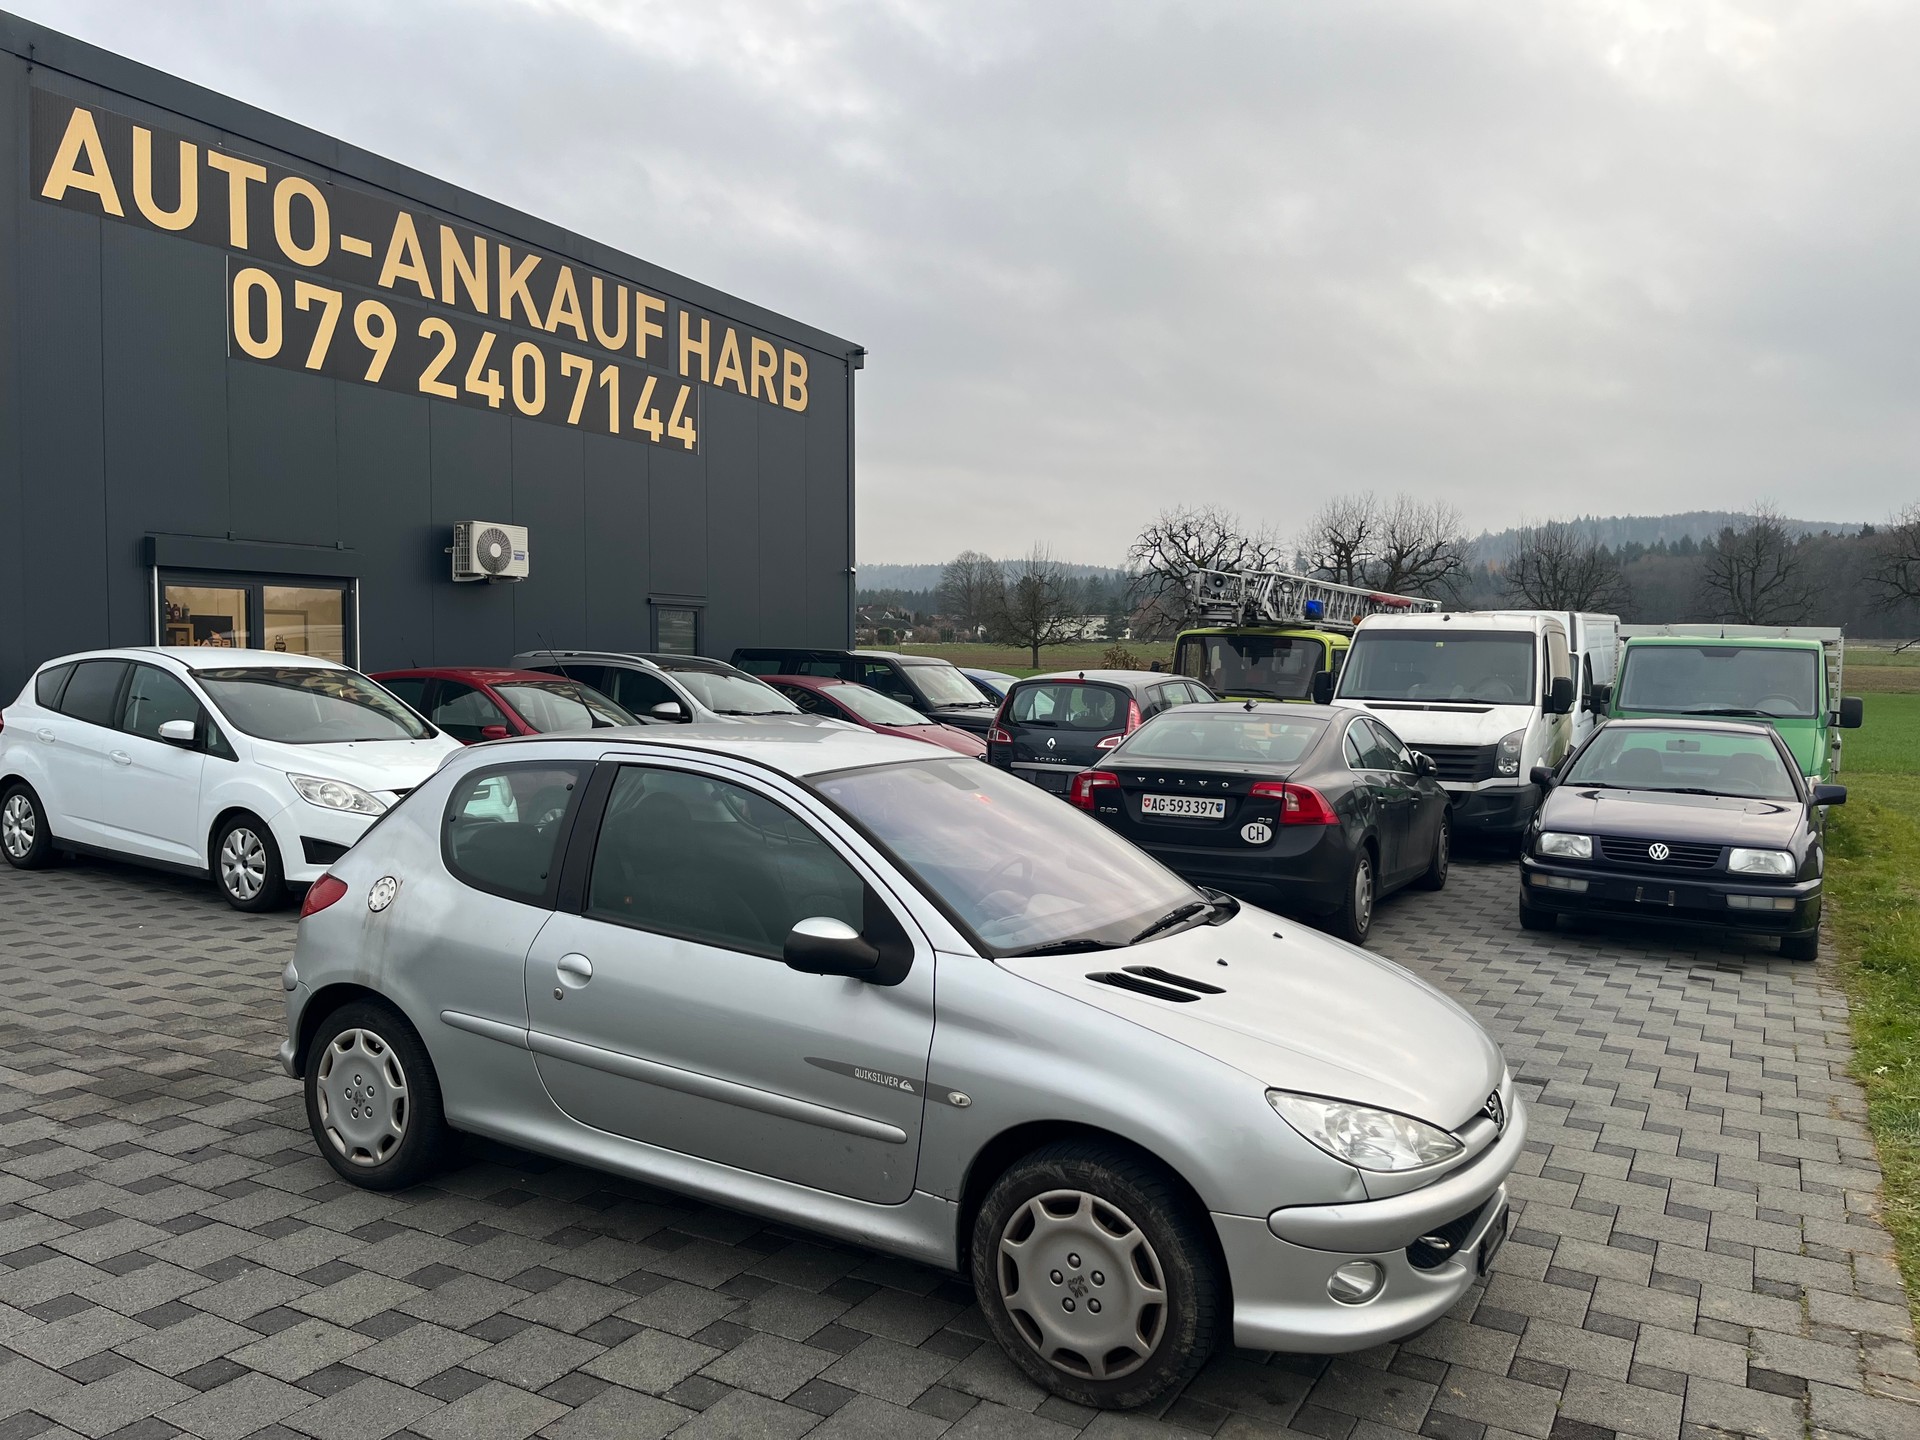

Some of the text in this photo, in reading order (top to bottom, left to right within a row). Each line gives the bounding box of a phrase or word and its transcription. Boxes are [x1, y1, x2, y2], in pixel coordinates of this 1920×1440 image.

[42, 107, 808, 412] AUTO-ANKAUF HARB
[233, 267, 398, 382] 079
[418, 316, 546, 416] 240
[1034, 756, 1067, 764] SCENIC
[1136, 776, 1229, 788] VOLVO
[1248, 825, 1265, 841] CH
[854, 1067, 899, 1088] QUIKSILVER
